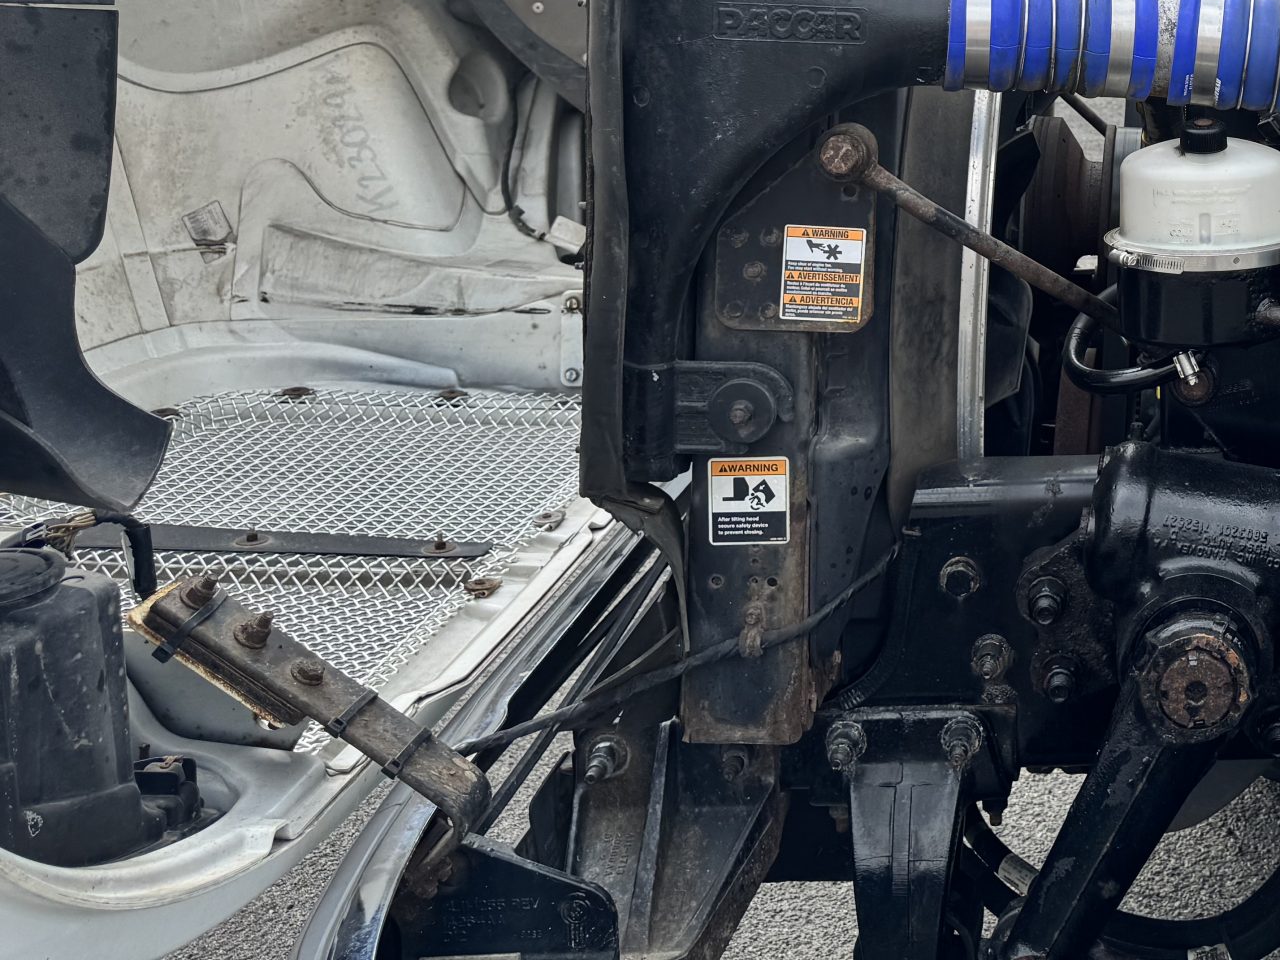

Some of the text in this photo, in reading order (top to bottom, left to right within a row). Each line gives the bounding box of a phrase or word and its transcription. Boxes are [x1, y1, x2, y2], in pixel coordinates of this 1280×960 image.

[716, 7, 862, 40] PACCAR
[812, 230, 848, 238] WARNING
[798, 272, 858, 282] AVERTISSEMENT
[800, 296, 853, 305] ADVERTENCIA
[728, 464, 778, 472] WARNING
